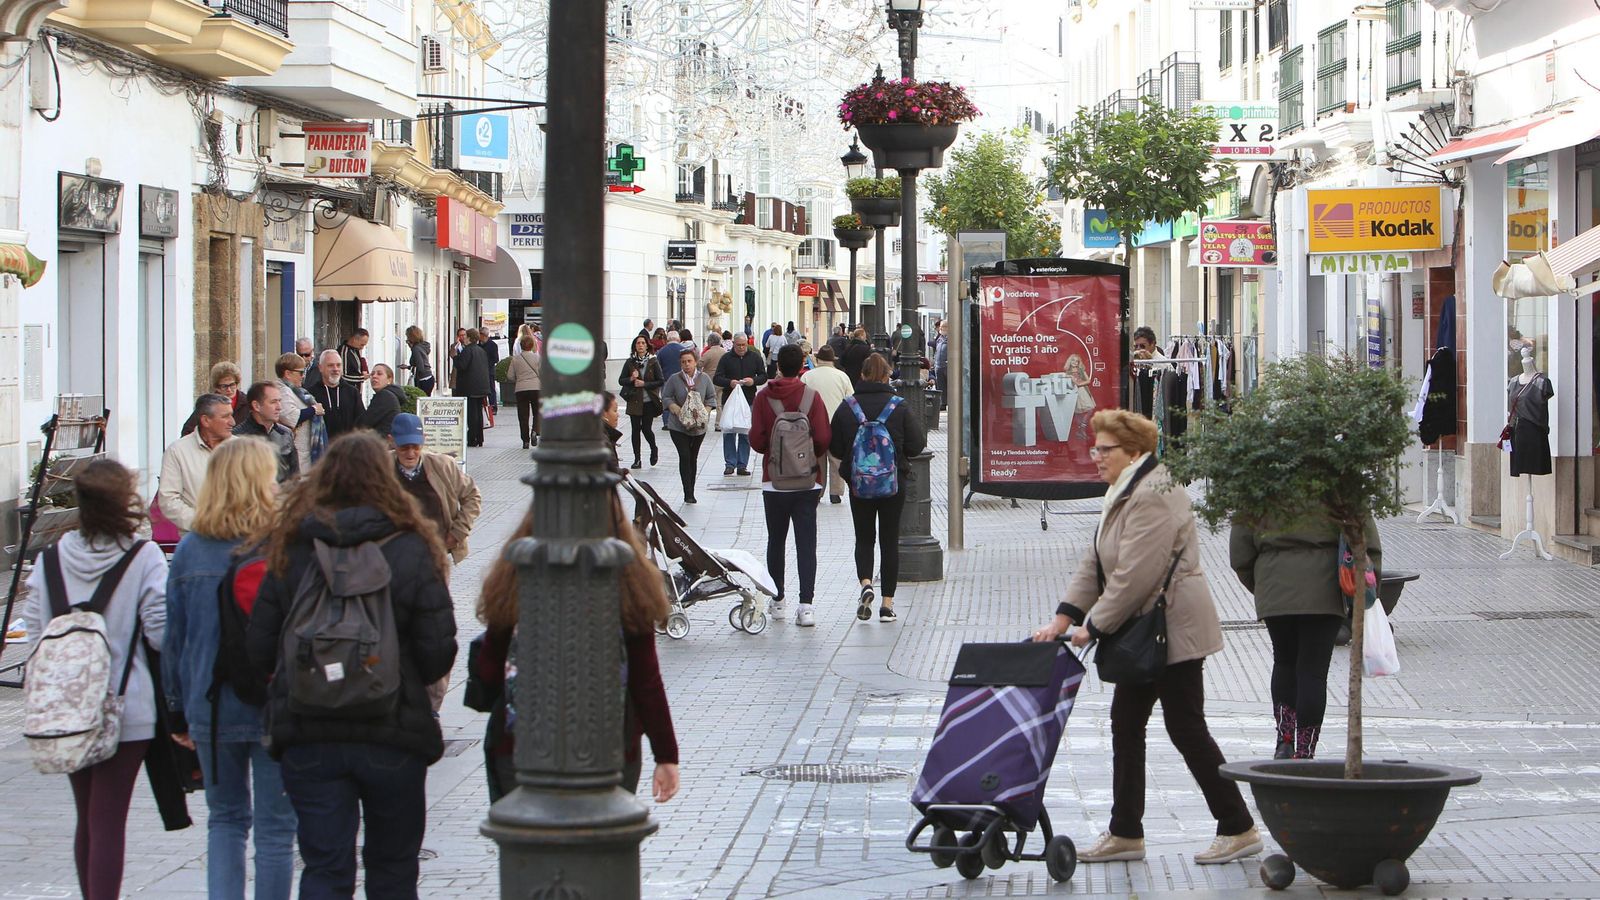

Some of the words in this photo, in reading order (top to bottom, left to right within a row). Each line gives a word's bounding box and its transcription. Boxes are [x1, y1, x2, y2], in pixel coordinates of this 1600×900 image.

[1229, 123, 1247, 142] X
[1259, 123, 1274, 142] 2
[307, 134, 367, 150] PANADERIA
[328, 158, 367, 173] BUTRON
[1358, 200, 1432, 215] PRODUCTOS
[1371, 219, 1435, 237] Kodak
[715, 253, 736, 262] katia
[1320, 253, 1398, 273] MIJITA
[1006, 290, 1040, 298] vodafone
[990, 333, 1034, 343] Vodafone
[1035, 333, 1057, 343] One.
[990, 345, 1004, 354] TV
[1005, 345, 1031, 357] gratis
[1033, 345, 1039, 354] 1
[1041, 345, 1059, 354] año
[990, 357, 1007, 366] con
[1014, 393, 1079, 447] TV
[990, 469, 1017, 477] Ready?
